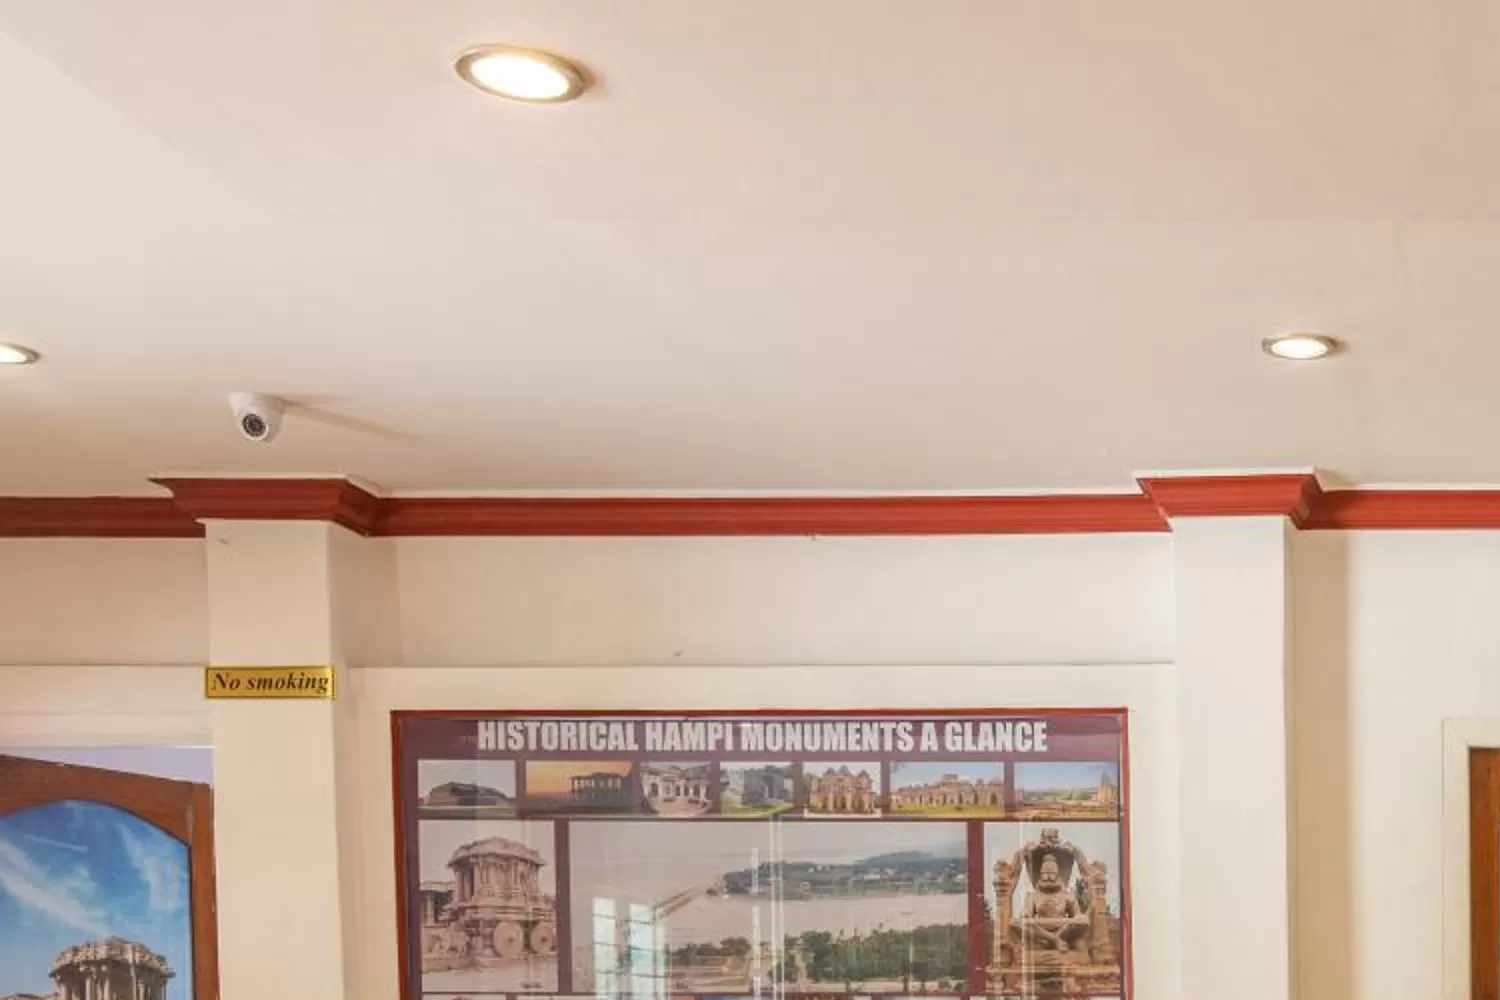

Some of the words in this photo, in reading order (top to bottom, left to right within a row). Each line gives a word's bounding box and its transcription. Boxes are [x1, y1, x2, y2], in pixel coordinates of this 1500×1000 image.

[211, 672, 241, 690] No
[247, 672, 329, 694] smoking
[477, 720, 639, 751] HISTORICAL
[645, 720, 733, 751] HAMPI
[741, 721, 913, 752] MONUMENTS
[920, 721, 939, 752] A
[945, 721, 1047, 752] GLANCE
